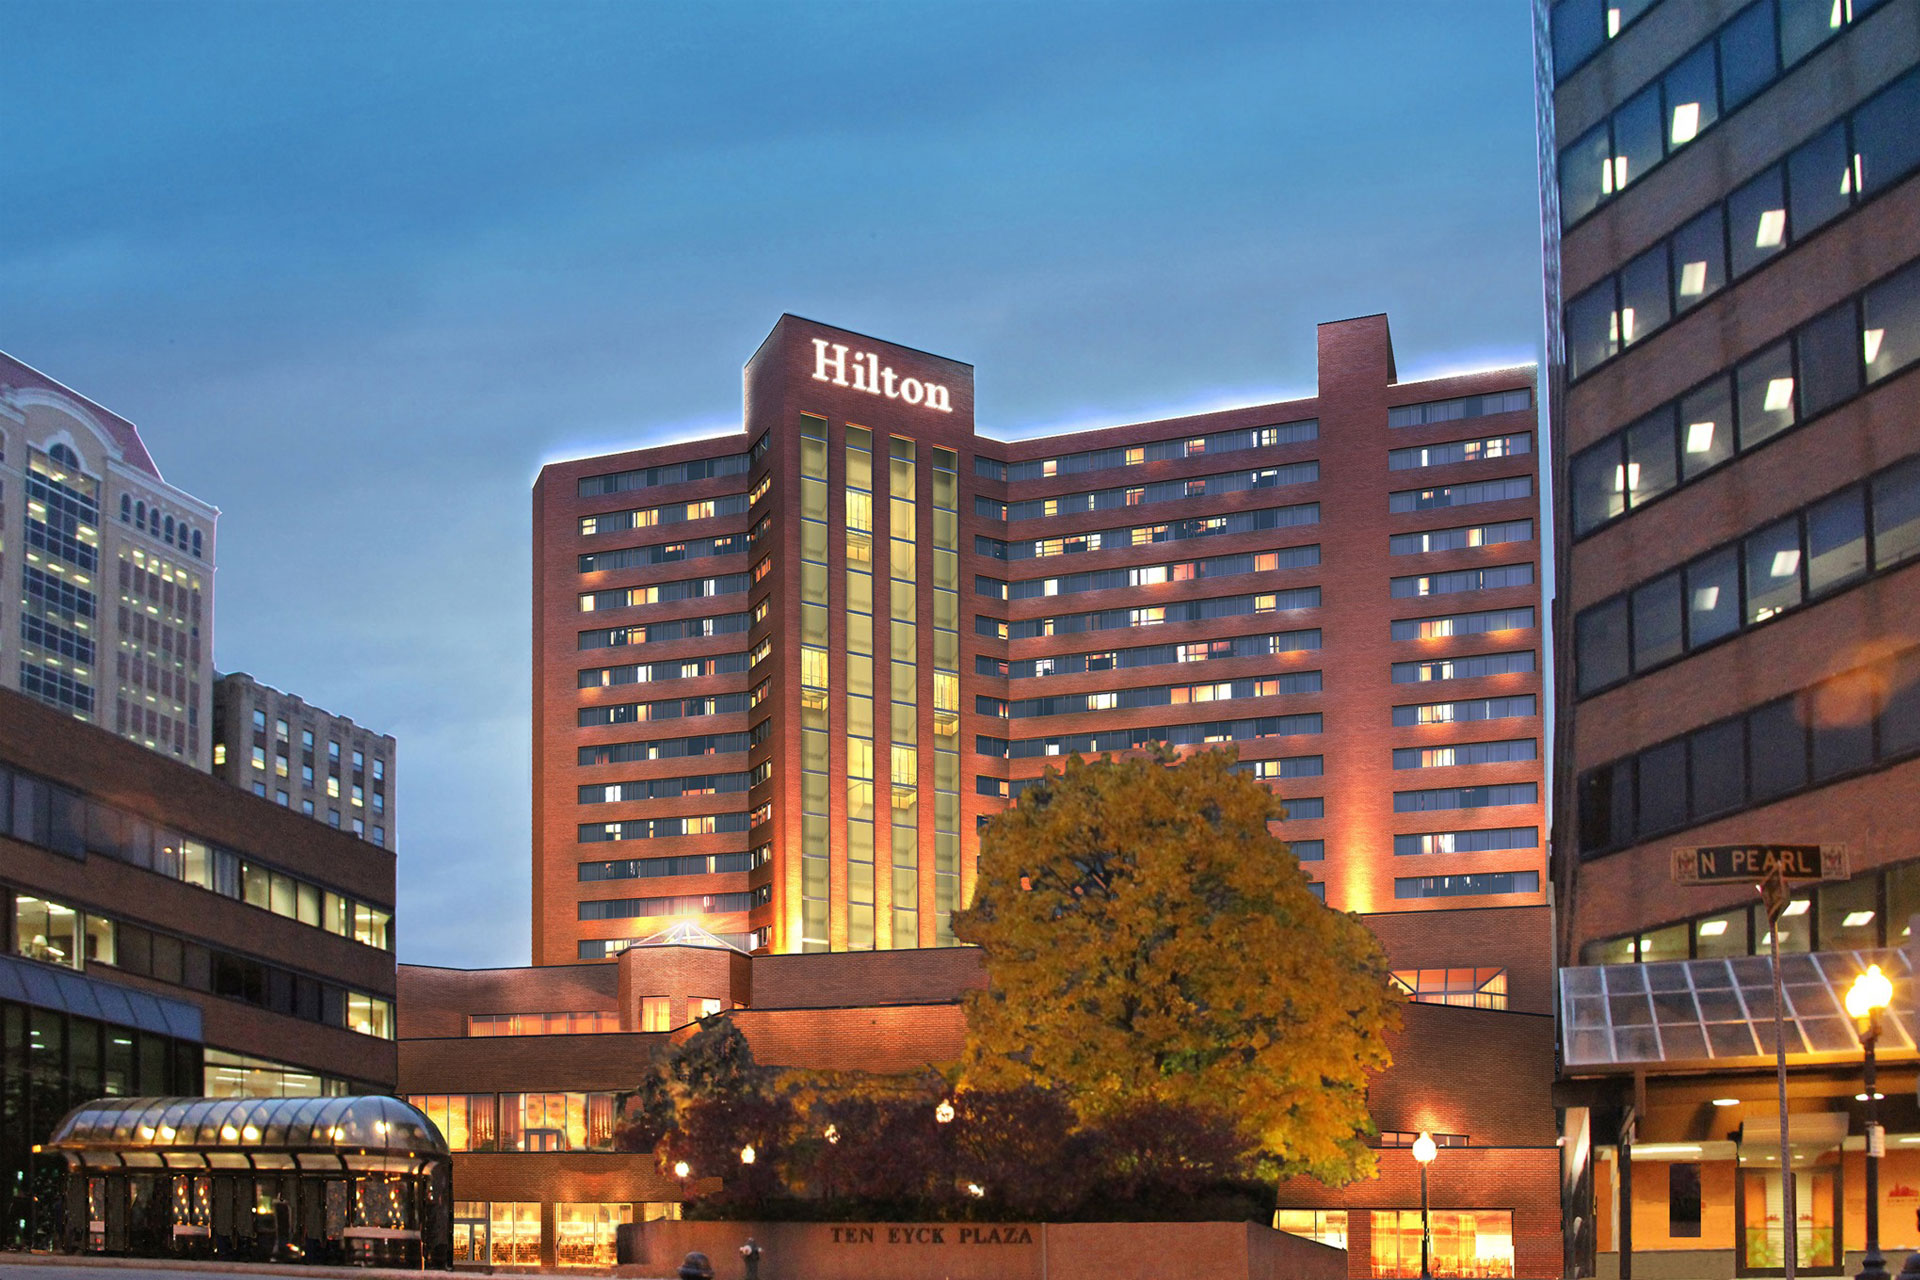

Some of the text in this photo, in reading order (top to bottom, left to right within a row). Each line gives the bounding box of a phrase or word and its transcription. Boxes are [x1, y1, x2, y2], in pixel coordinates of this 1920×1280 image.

[812, 338, 953, 412] Hilton
[1700, 851, 1717, 875] N
[1731, 850, 1813, 873] PEARL
[831, 1228, 1033, 1244] TEN EYCK PLAZA
